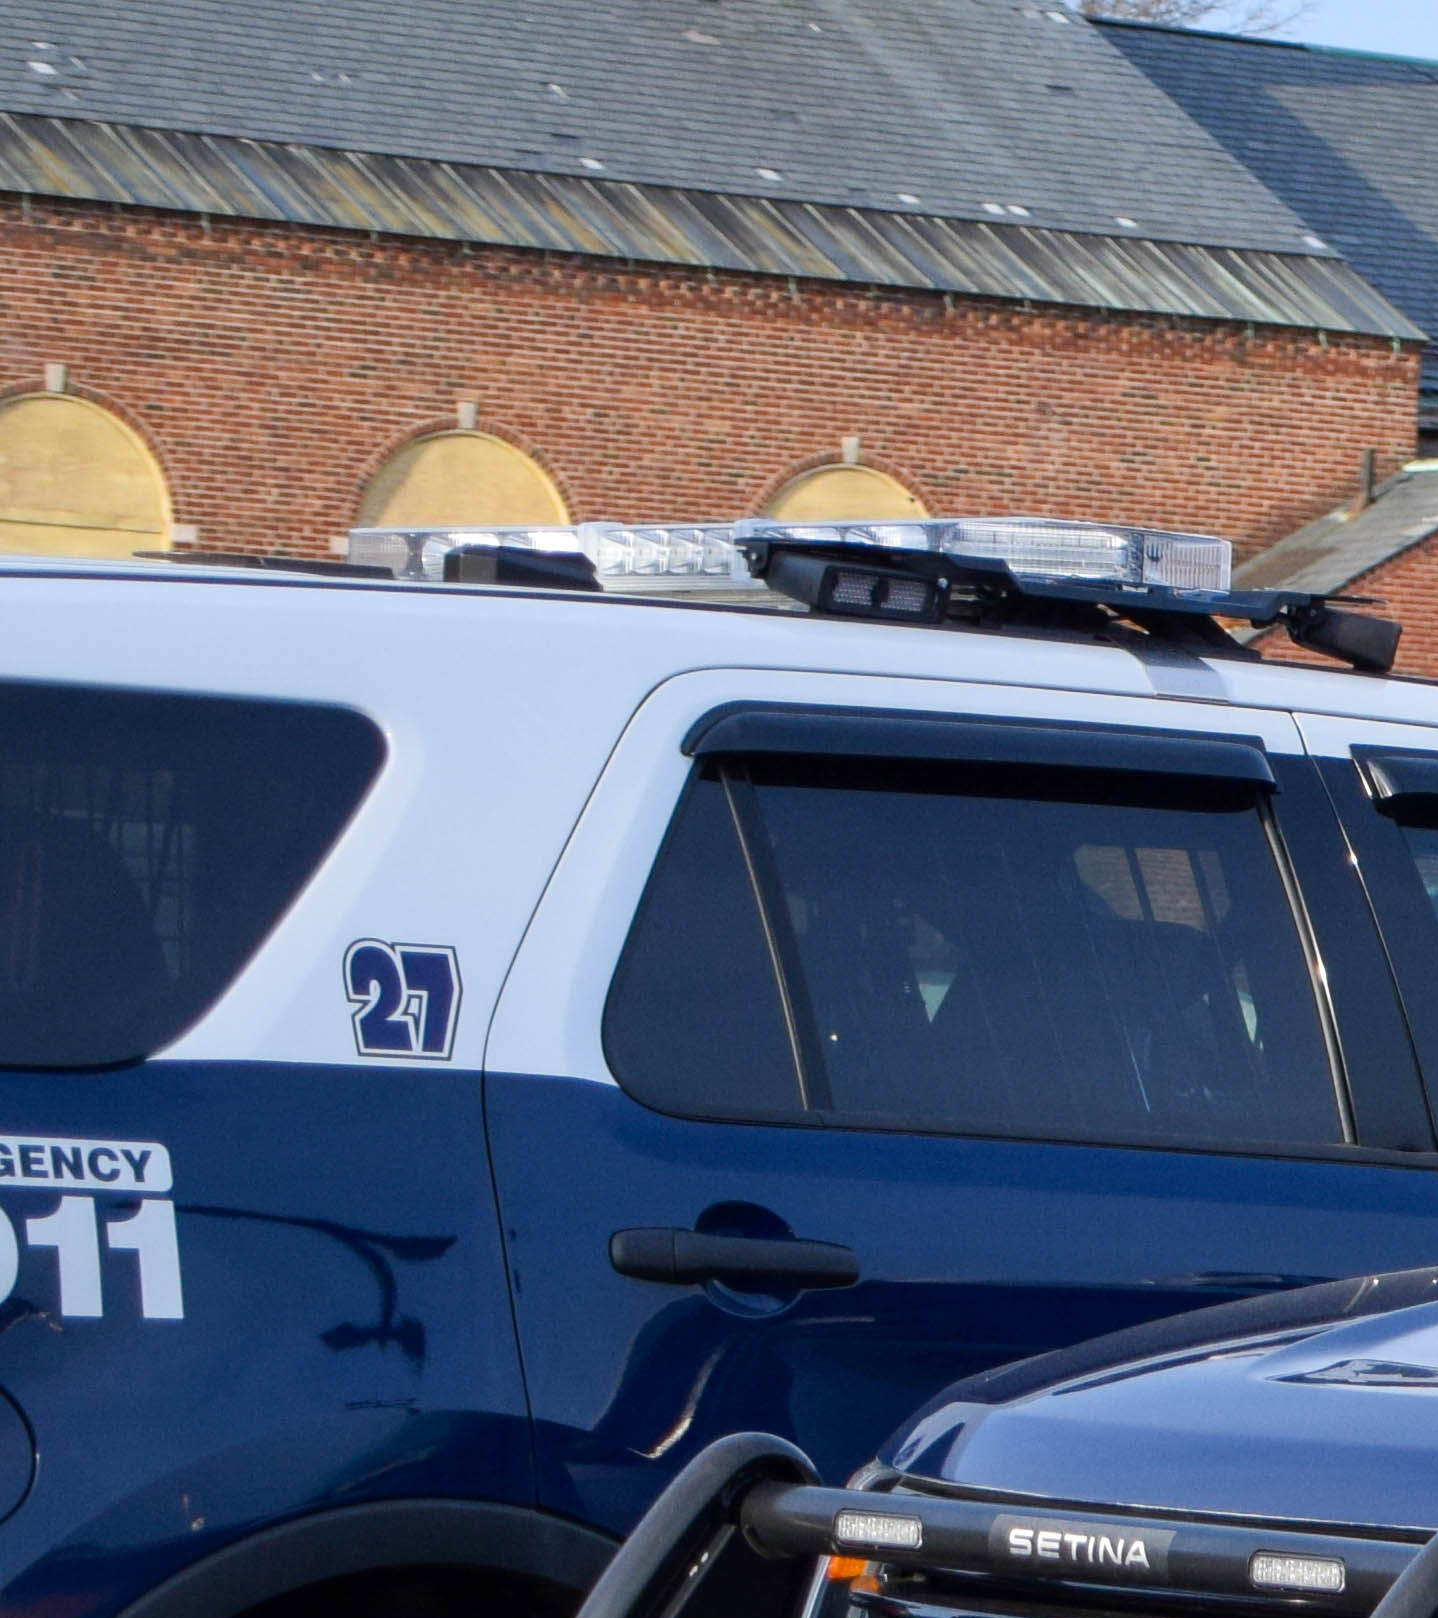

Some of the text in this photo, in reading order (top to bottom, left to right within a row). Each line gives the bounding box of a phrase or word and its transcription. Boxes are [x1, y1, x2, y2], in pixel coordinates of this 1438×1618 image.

[343, 937, 463, 1061] 27
[0, 1195, 184, 1319] 11
[1008, 1527, 1150, 1568] SETINA
